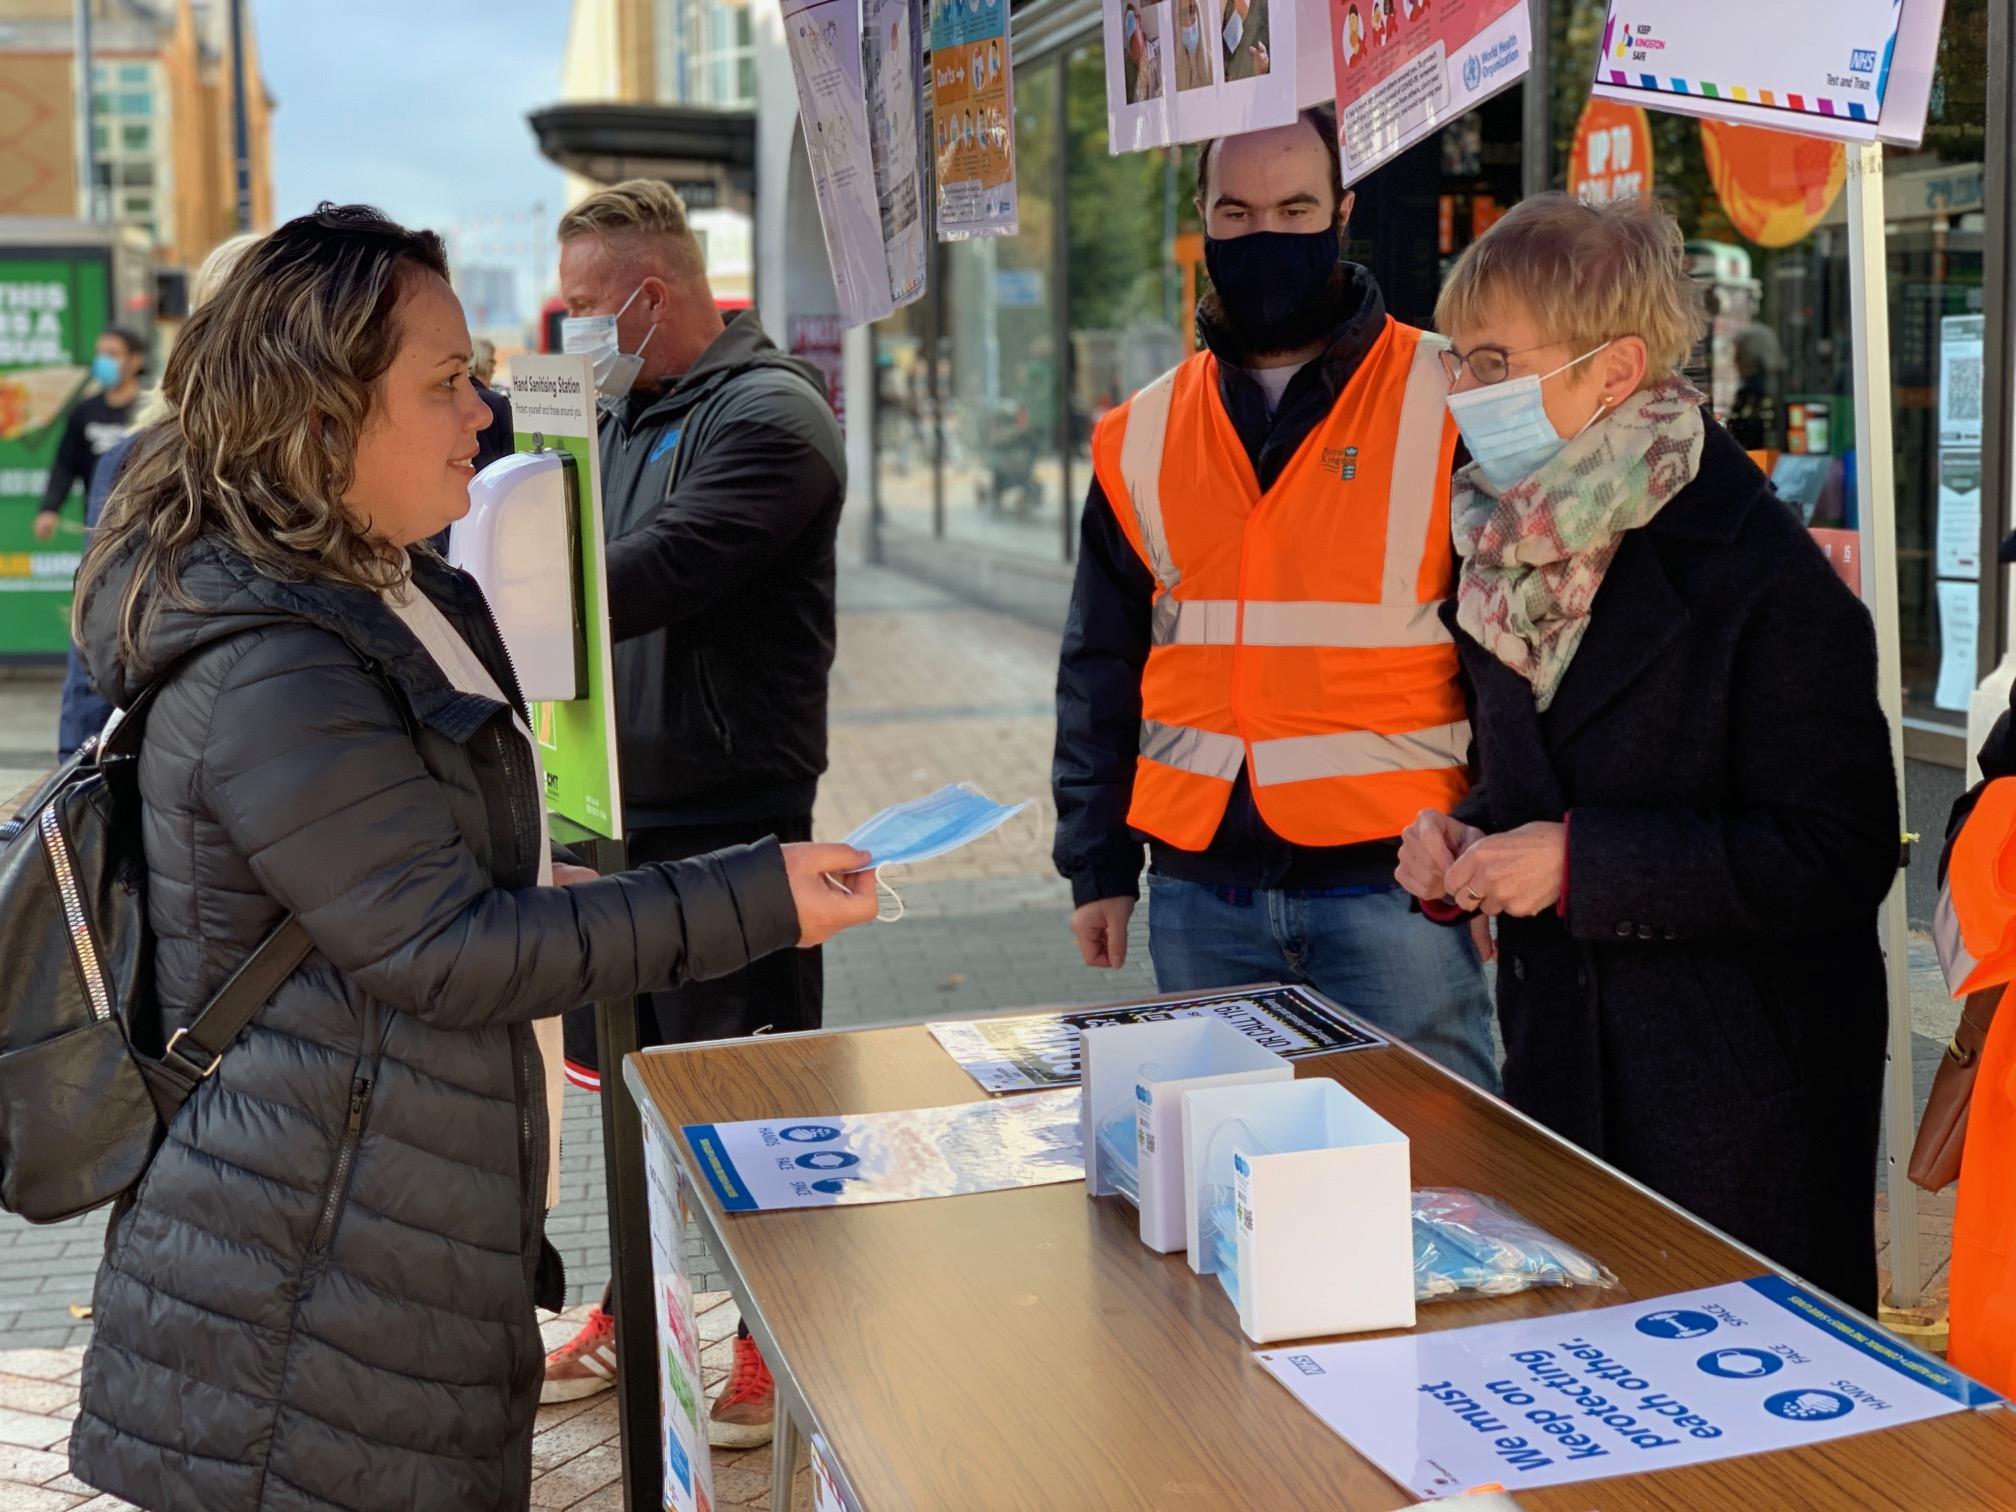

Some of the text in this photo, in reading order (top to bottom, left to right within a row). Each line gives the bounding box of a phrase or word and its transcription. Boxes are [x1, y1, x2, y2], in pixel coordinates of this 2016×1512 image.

[1637, 25, 1651, 35] KEEP
[1482, 33, 1518, 63] World Health
[1635, 38, 1665, 49] KINGSTON
[1483, 49, 1519, 78] Organization
[1633, 51, 1646, 61] SAFE
[1850, 50, 1876, 72] NHS
[1827, 73, 1870, 90] Test and Trace
[1588, 124, 1633, 176] UP TO
[514, 376, 581, 398] Hand Sanitising Station
[1214, 1005, 1248, 1022] 119
[1233, 1016, 1275, 1038] CALL
[1256, 1033, 1292, 1048] OR
[758, 1127, 813, 1198] HANDS FACE SPACE
[1288, 1355, 1326, 1375] NHS
[1702, 1303, 1892, 1411] HANDS FACE SPACE
[1557, 1337, 1723, 1439] each other.
[1510, 1349, 1681, 1450] protecting
[1416, 1380, 1554, 1472] We must
[1485, 1379, 1611, 1461] keep on
